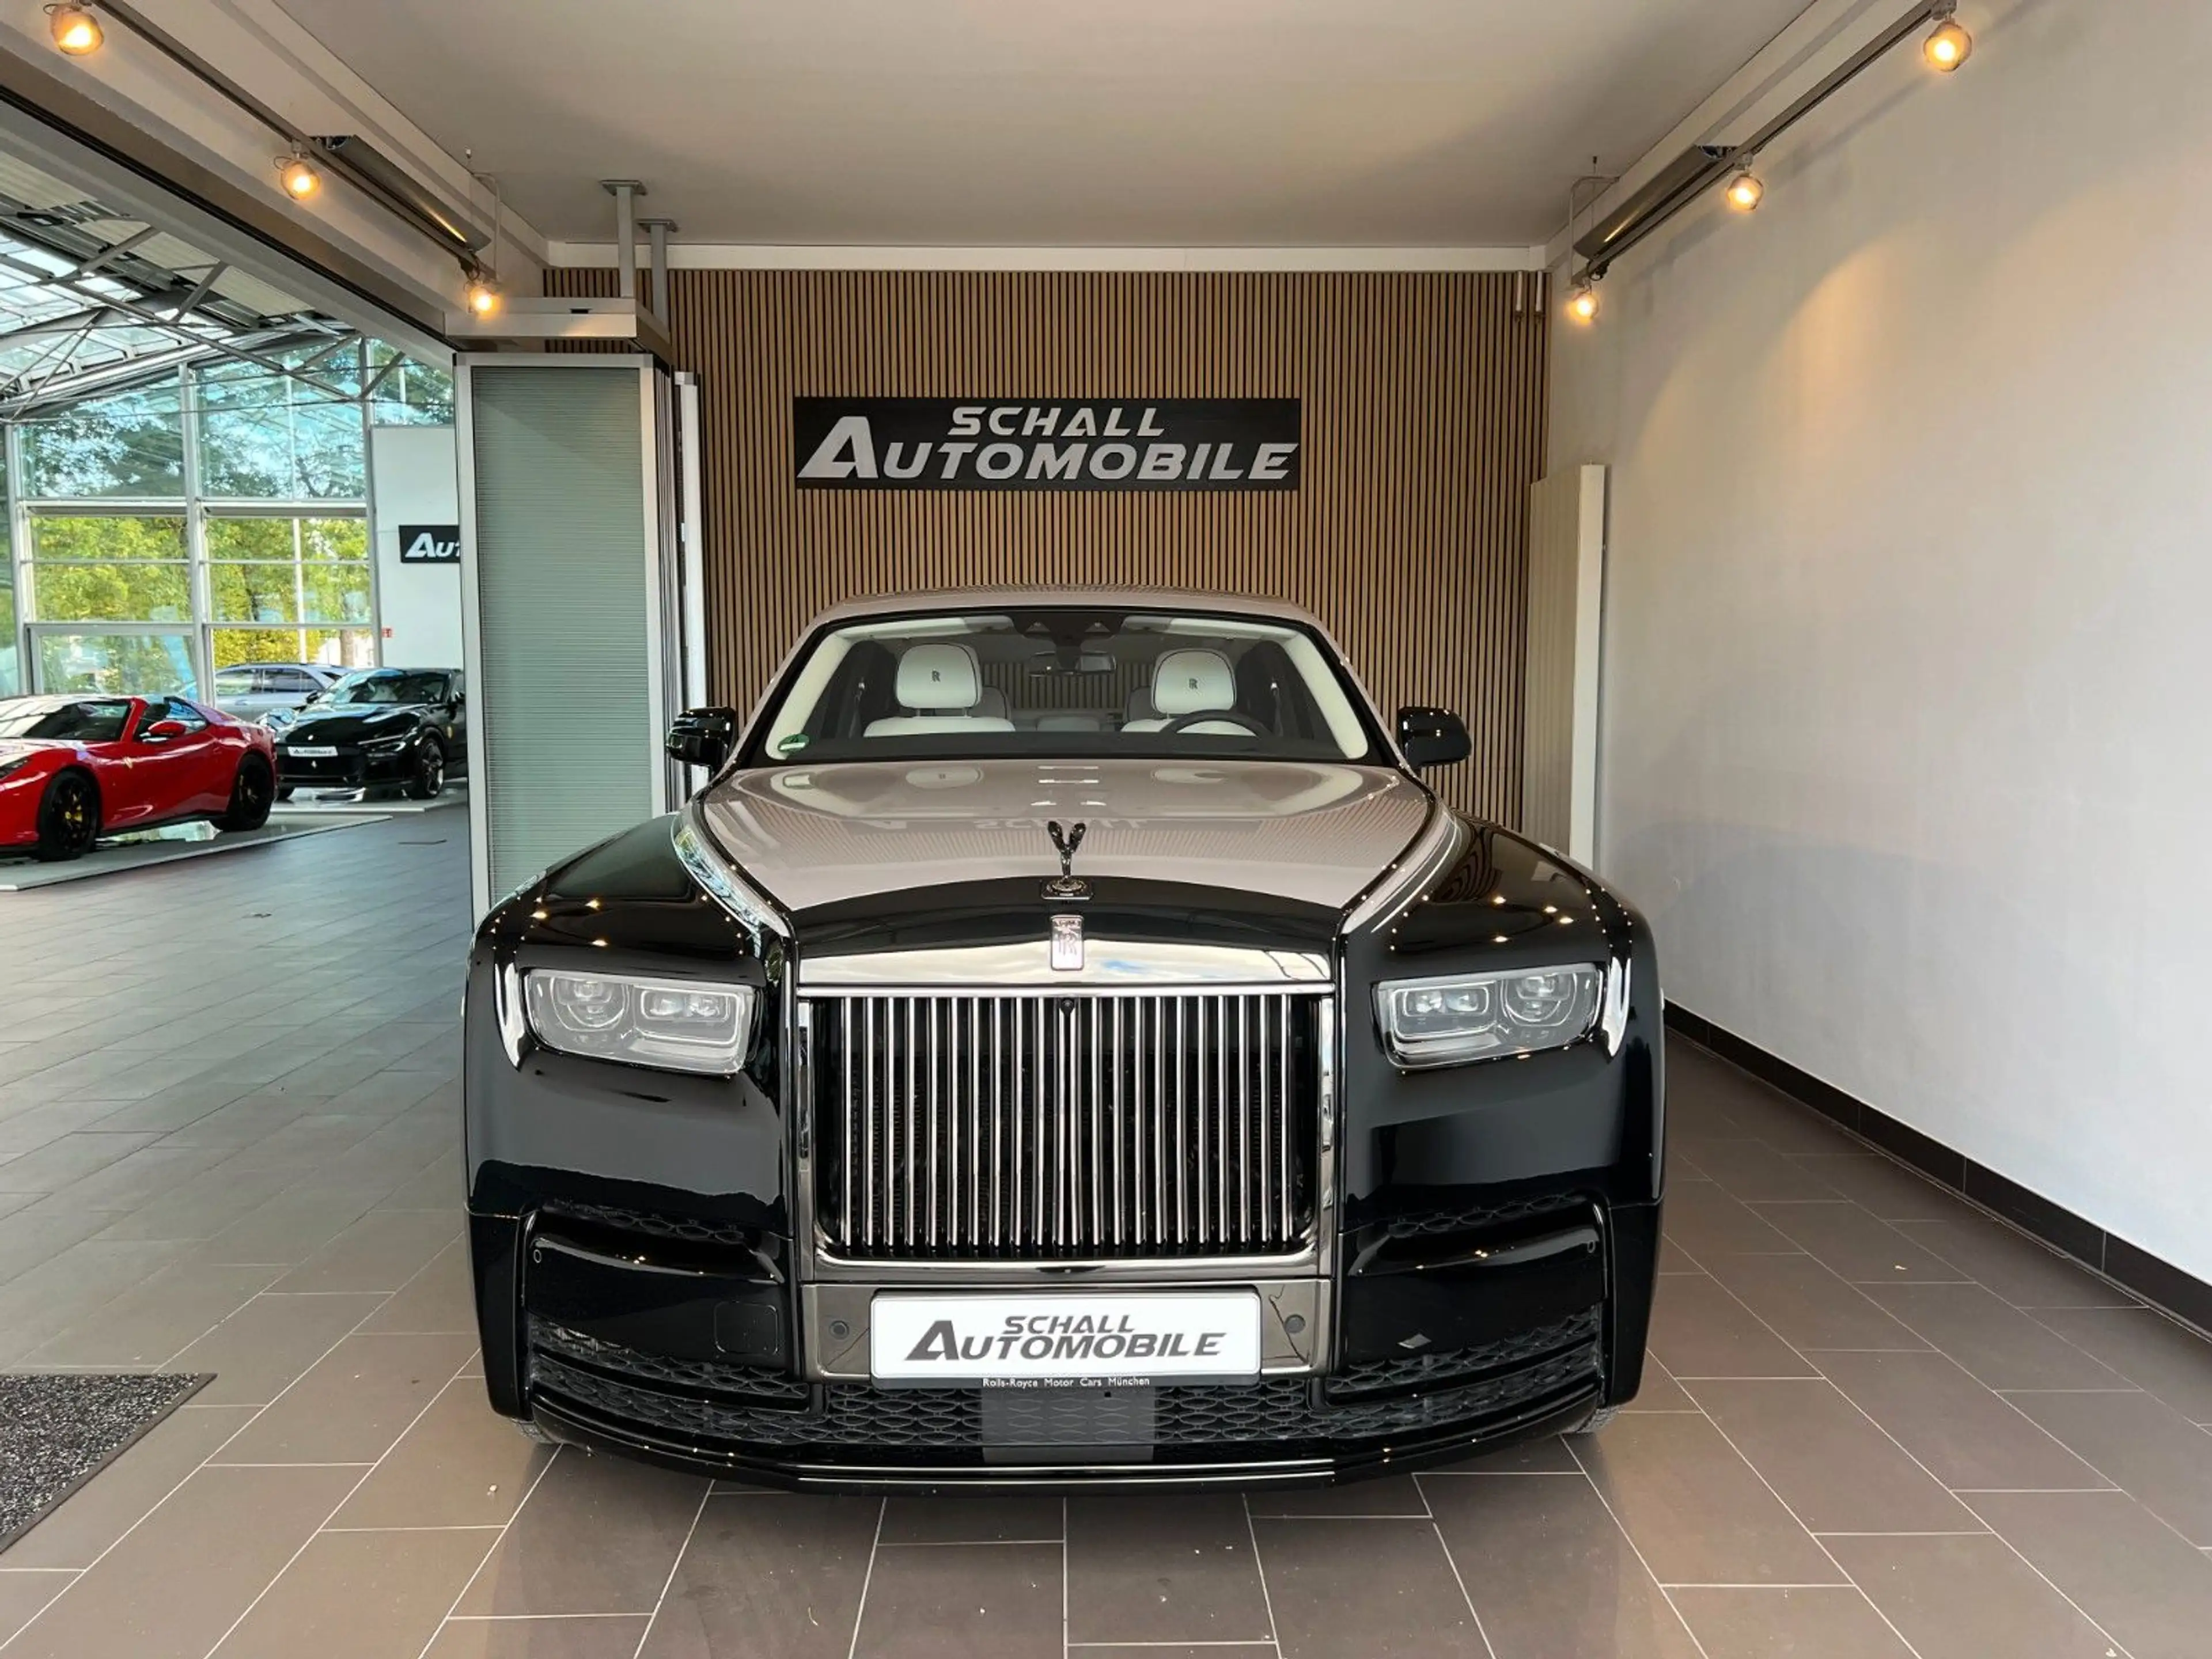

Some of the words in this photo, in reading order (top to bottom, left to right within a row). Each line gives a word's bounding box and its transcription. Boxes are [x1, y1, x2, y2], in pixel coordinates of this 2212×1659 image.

[948, 407, 1168, 437] SCHALL
[797, 416, 1299, 480] AUTOMOBILE
[904, 1320, 1227, 1360] AUTOMOBILE
[1002, 1315, 1135, 1335] SCHALL
[1044, 1377, 1074, 1387] Motor
[1080, 1376, 1103, 1387] Cars
[1108, 1375, 1150, 1387] München
